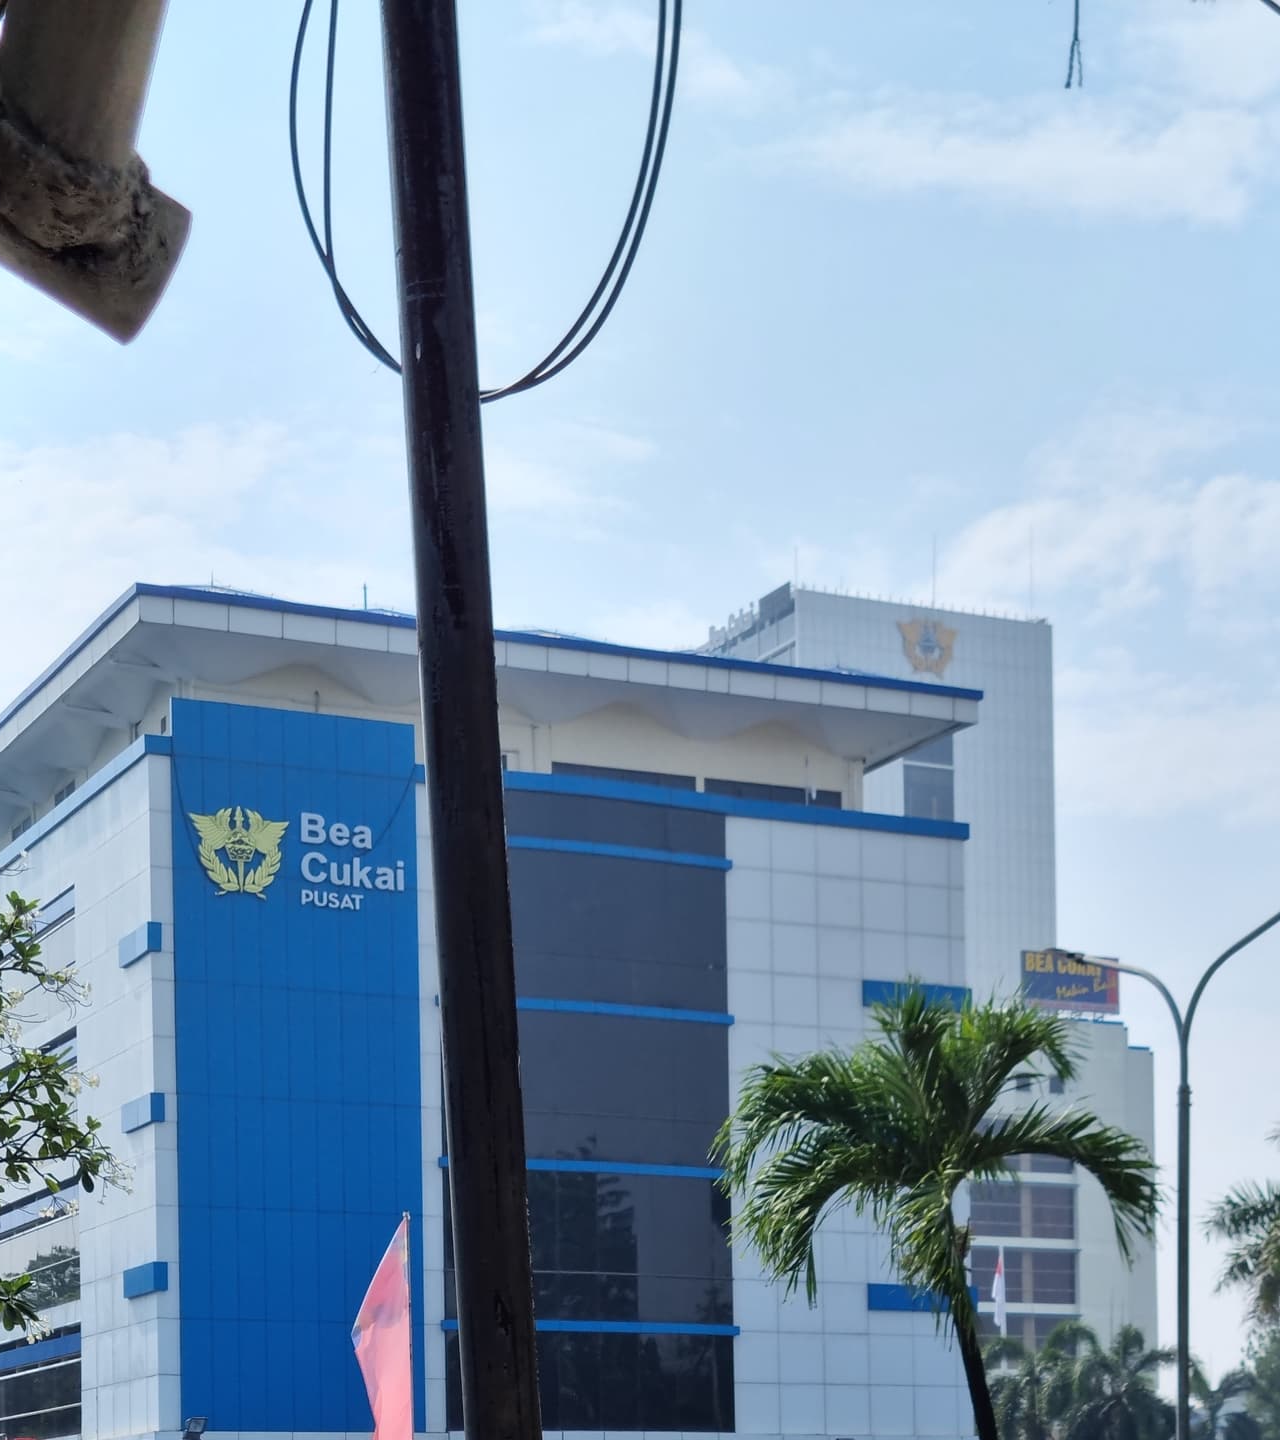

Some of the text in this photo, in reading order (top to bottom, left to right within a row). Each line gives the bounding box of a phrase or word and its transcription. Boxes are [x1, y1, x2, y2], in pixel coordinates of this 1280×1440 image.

[300, 812, 373, 850] Bea
[300, 852, 406, 892] Cukai
[301, 889, 364, 911] PUSAT
[1024, 951, 1054, 973] BEA
